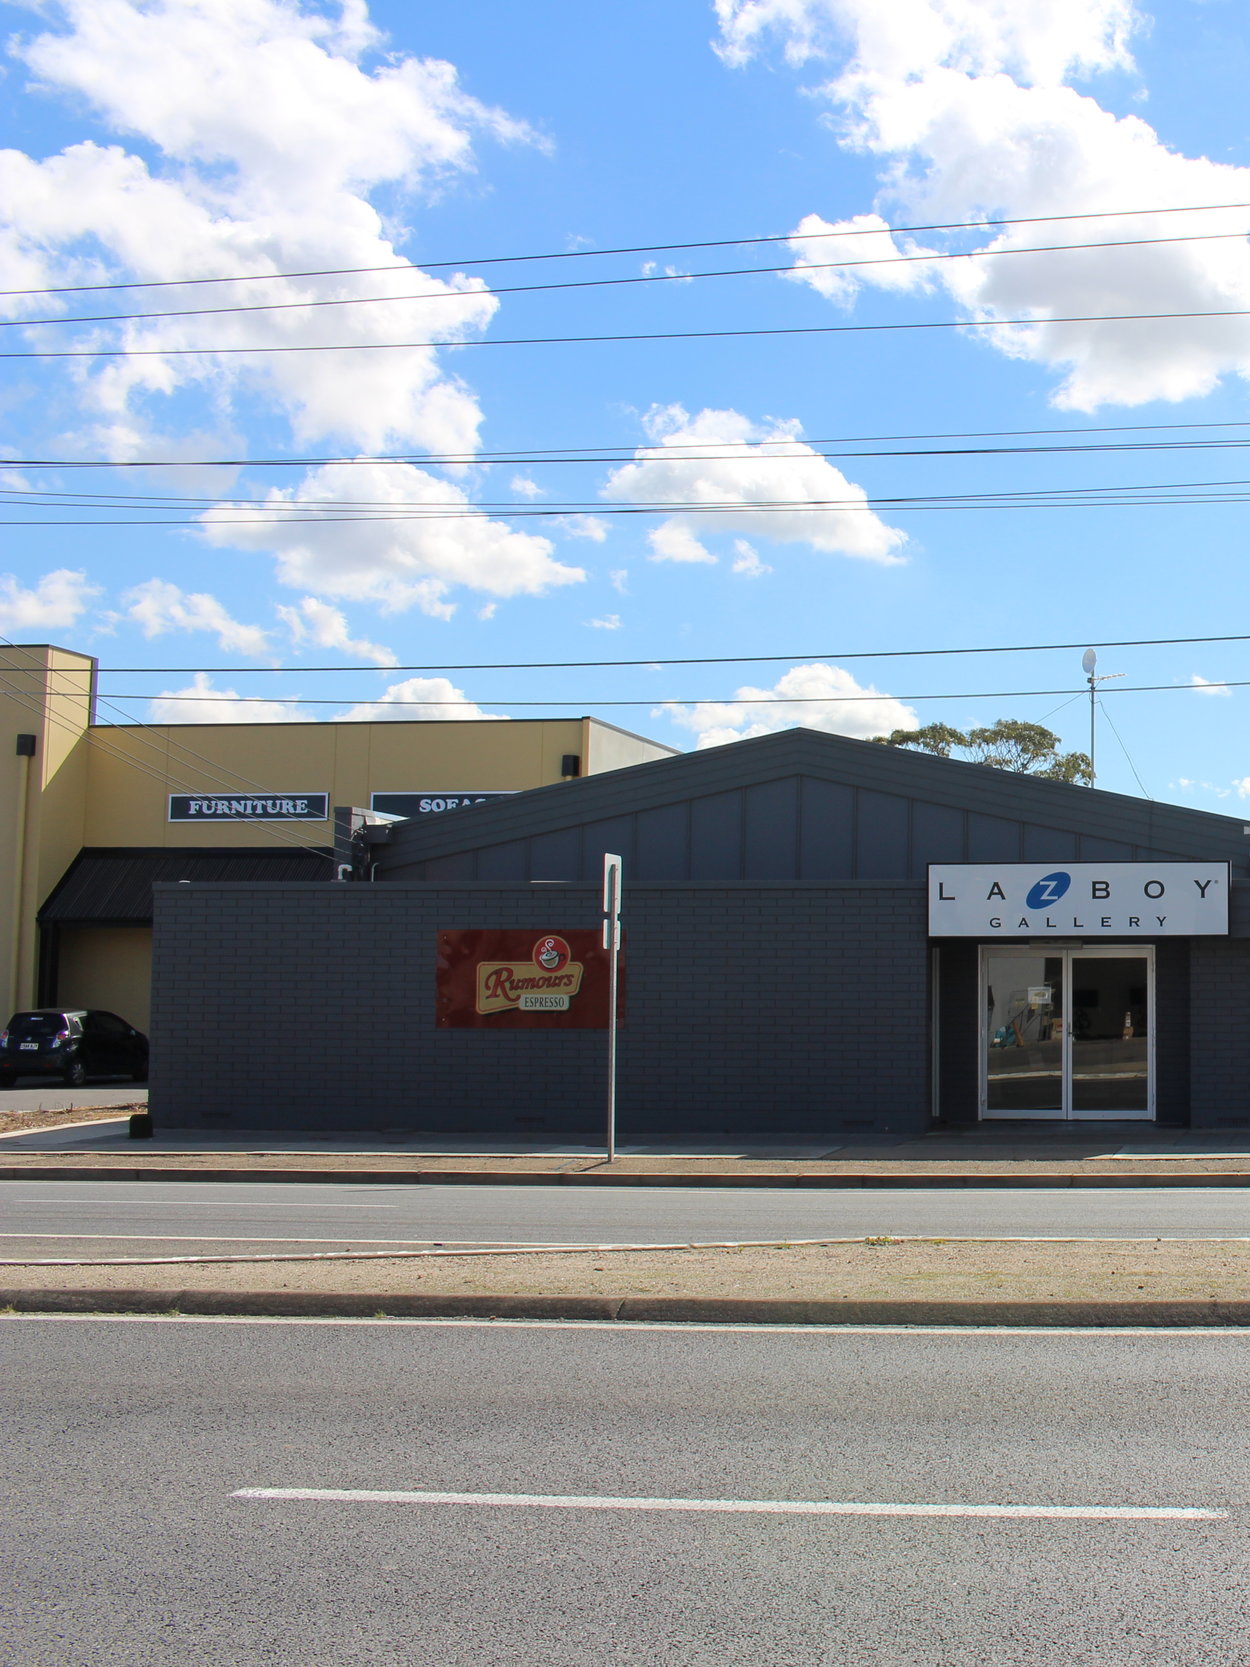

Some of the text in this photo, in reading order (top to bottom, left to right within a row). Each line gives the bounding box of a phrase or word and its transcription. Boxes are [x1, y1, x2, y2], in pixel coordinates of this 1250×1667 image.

[188, 800, 308, 814] FURNITURE
[989, 917, 1167, 928] GALLERY
[484, 967, 575, 1002] Rumours
[524, 996, 565, 1008] ESPRESSO
